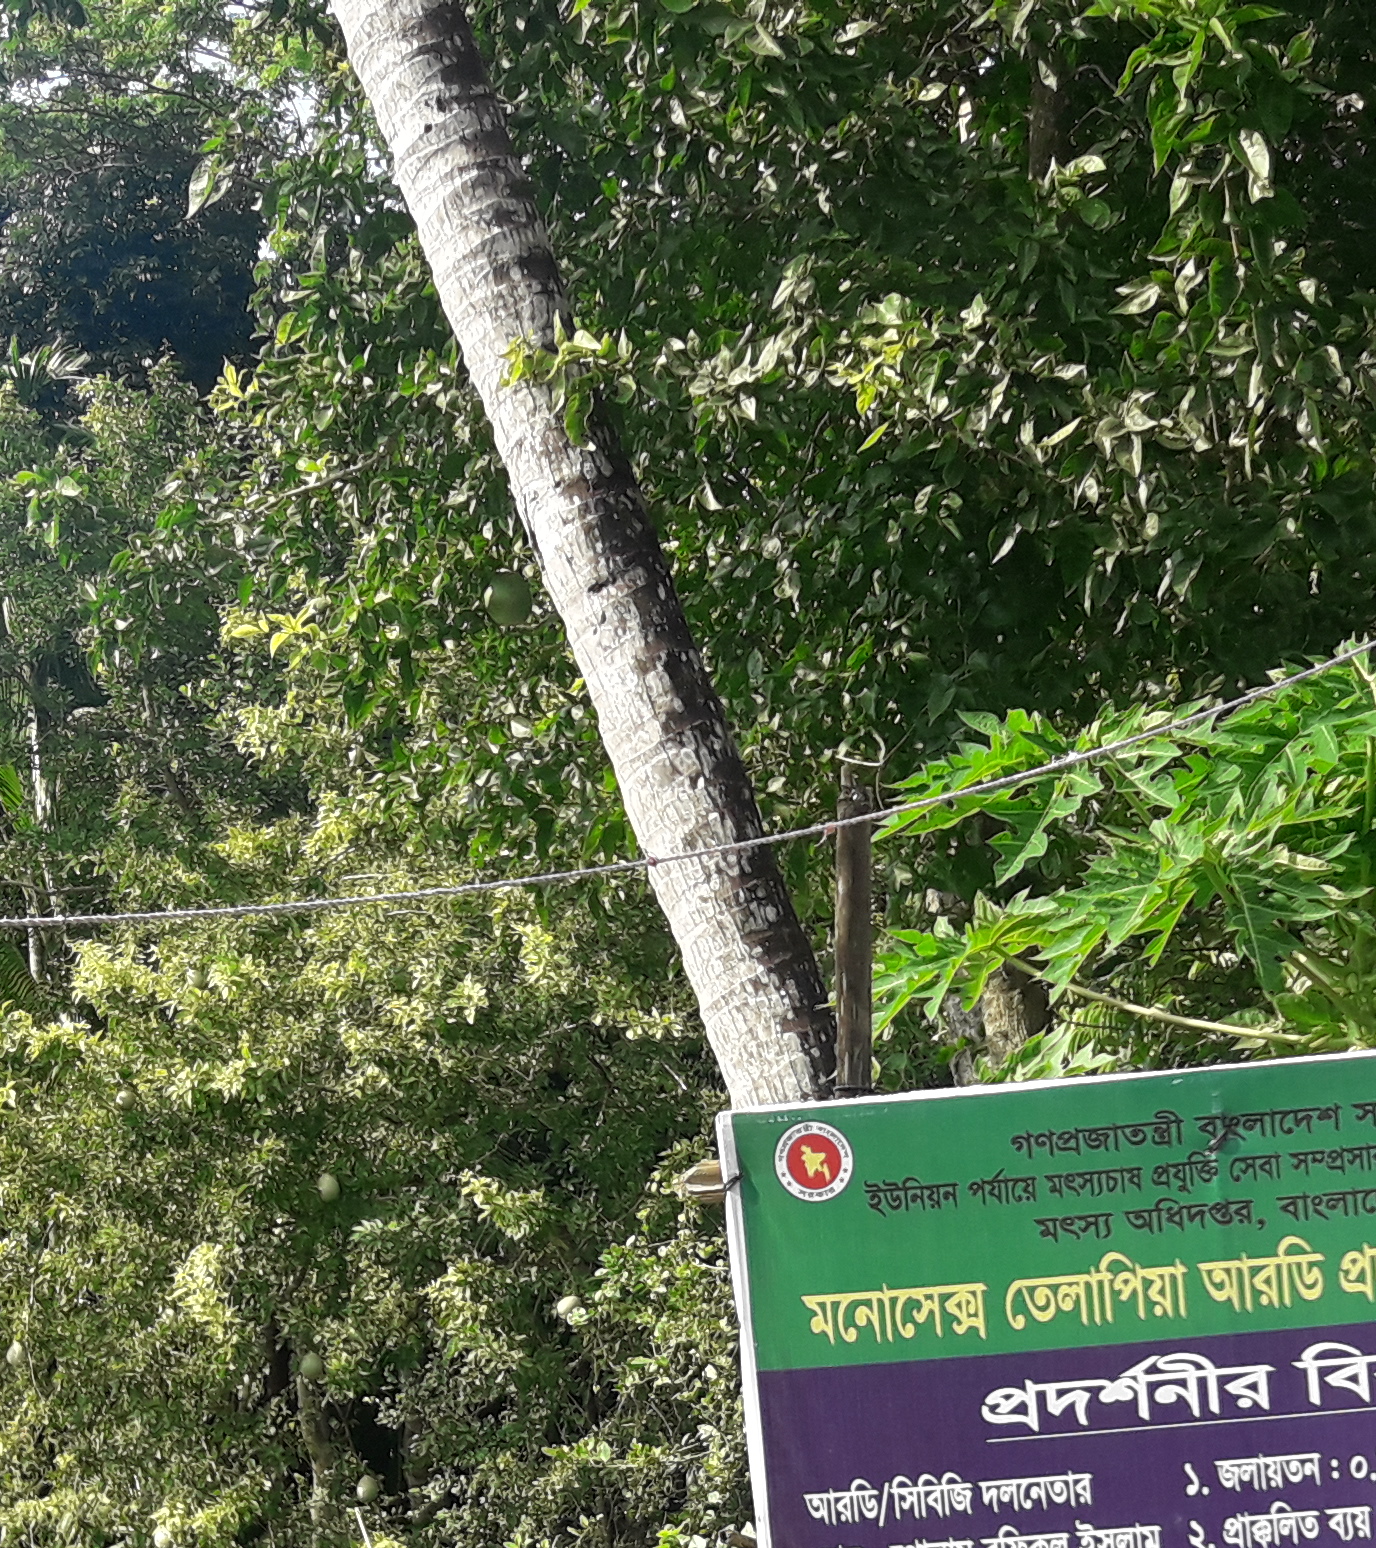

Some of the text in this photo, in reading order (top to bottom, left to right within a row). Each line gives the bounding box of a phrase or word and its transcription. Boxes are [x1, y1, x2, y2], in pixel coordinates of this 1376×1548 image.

[1010, 1110, 1184, 1162] গণপ্রজাতন্ত্রী
[1194, 1103, 1342, 1142] বাংলাদেশ
[862, 1176, 959, 1218] ইউনিয়ন
[968, 1168, 1038, 1206] পর্যায়ে
[1044, 1166, 1143, 1199] মৎস্যচাষ
[1151, 1150, 1219, 1194] প্রযুক্তি
[1229, 1152, 1281, 1183] সেবা
[1034, 1211, 1114, 1244] মৎস্য
[1123, 1196, 1268, 1236] অধিদপ্তর,
[800, 1283, 989, 1346] মনোসেক্স
[1003, 1250, 1188, 1332] তেলাপিয়া
[1196, 1234, 1326, 1314] আরডি
[980, 1350, 1278, 1433] প্রদর্শনীর
[803, 1470, 1094, 1528] আরডি/সিবিজি দলনেতার
[1214, 1450, 1323, 1493] জলায়তন
[1323, 1504, 1373, 1542] ব্যয়
